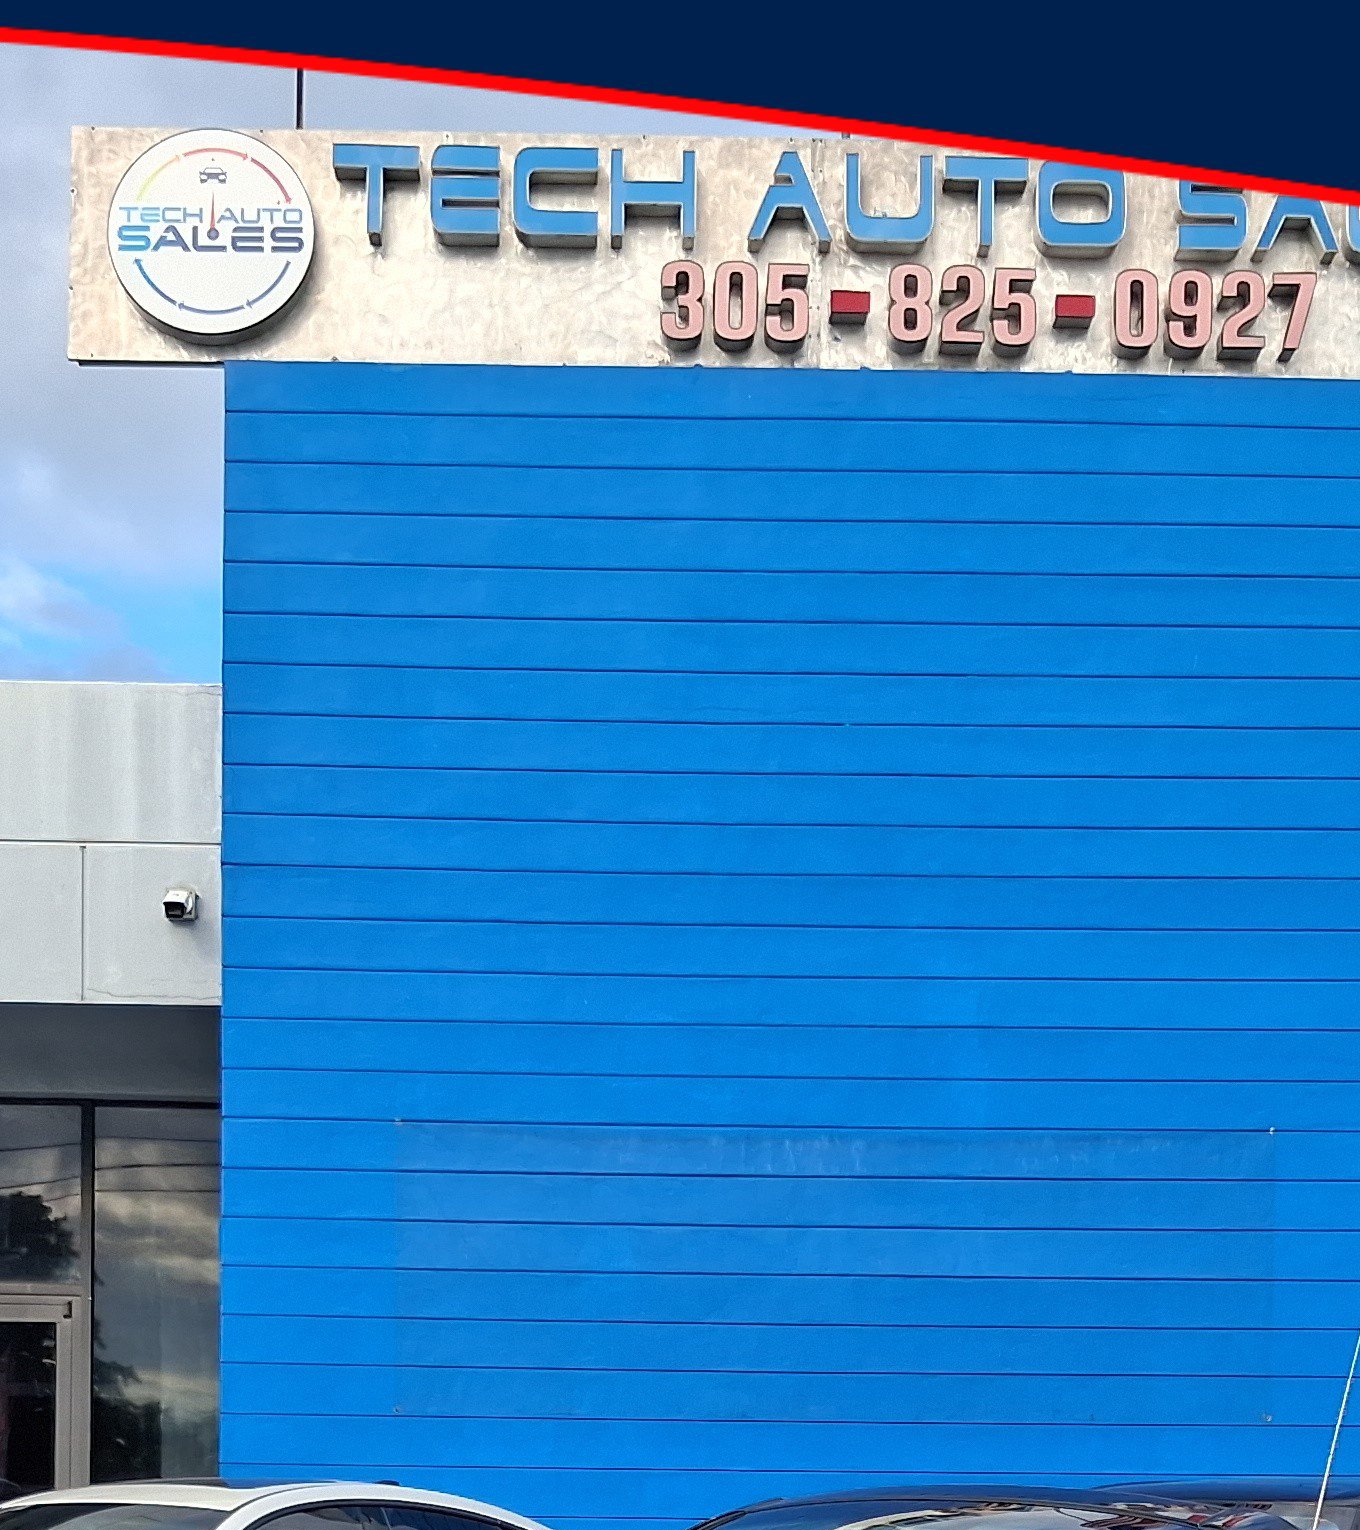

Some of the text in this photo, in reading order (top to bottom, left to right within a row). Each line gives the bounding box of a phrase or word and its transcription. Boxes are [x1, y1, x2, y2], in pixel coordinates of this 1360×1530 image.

[118, 206, 303, 224] TECH AUTO
[333, 143, 696, 248] TECH
[748, 149, 1126, 250] AUTO
[117, 224, 305, 253] SALES
[660, 260, 1318, 352] 305-825-0927
